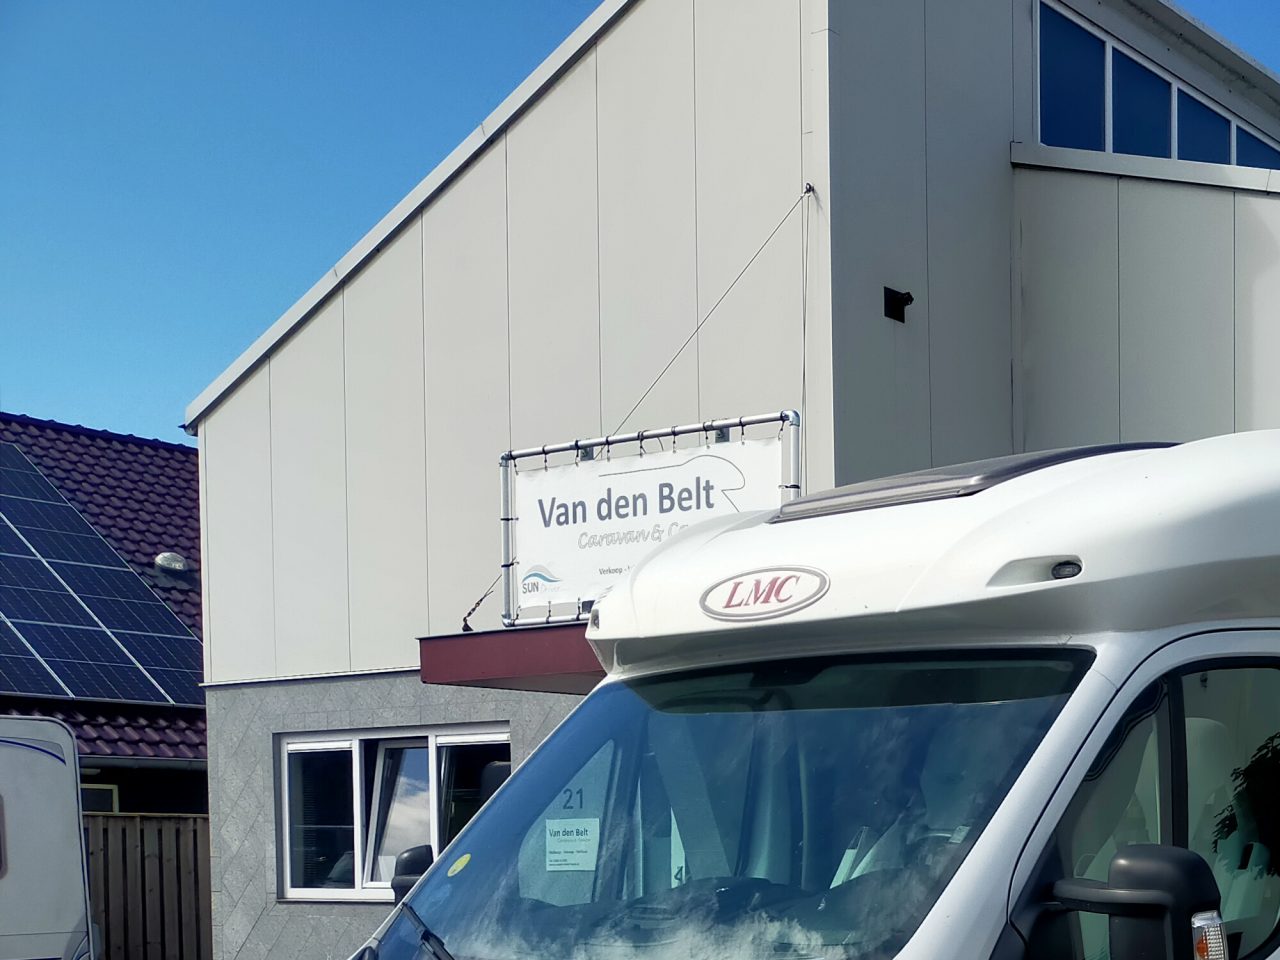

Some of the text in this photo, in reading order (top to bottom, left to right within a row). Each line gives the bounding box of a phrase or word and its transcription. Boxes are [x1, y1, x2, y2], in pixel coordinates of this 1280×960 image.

[538, 476, 715, 528] Van den Belt
[578, 530, 651, 549] Caravan
[651, 523, 665, 542] &
[522, 581, 539, 594] SUN
[723, 575, 800, 610] LMC
[562, 788, 584, 809] 21
[549, 828, 588, 838] Van den Belt
